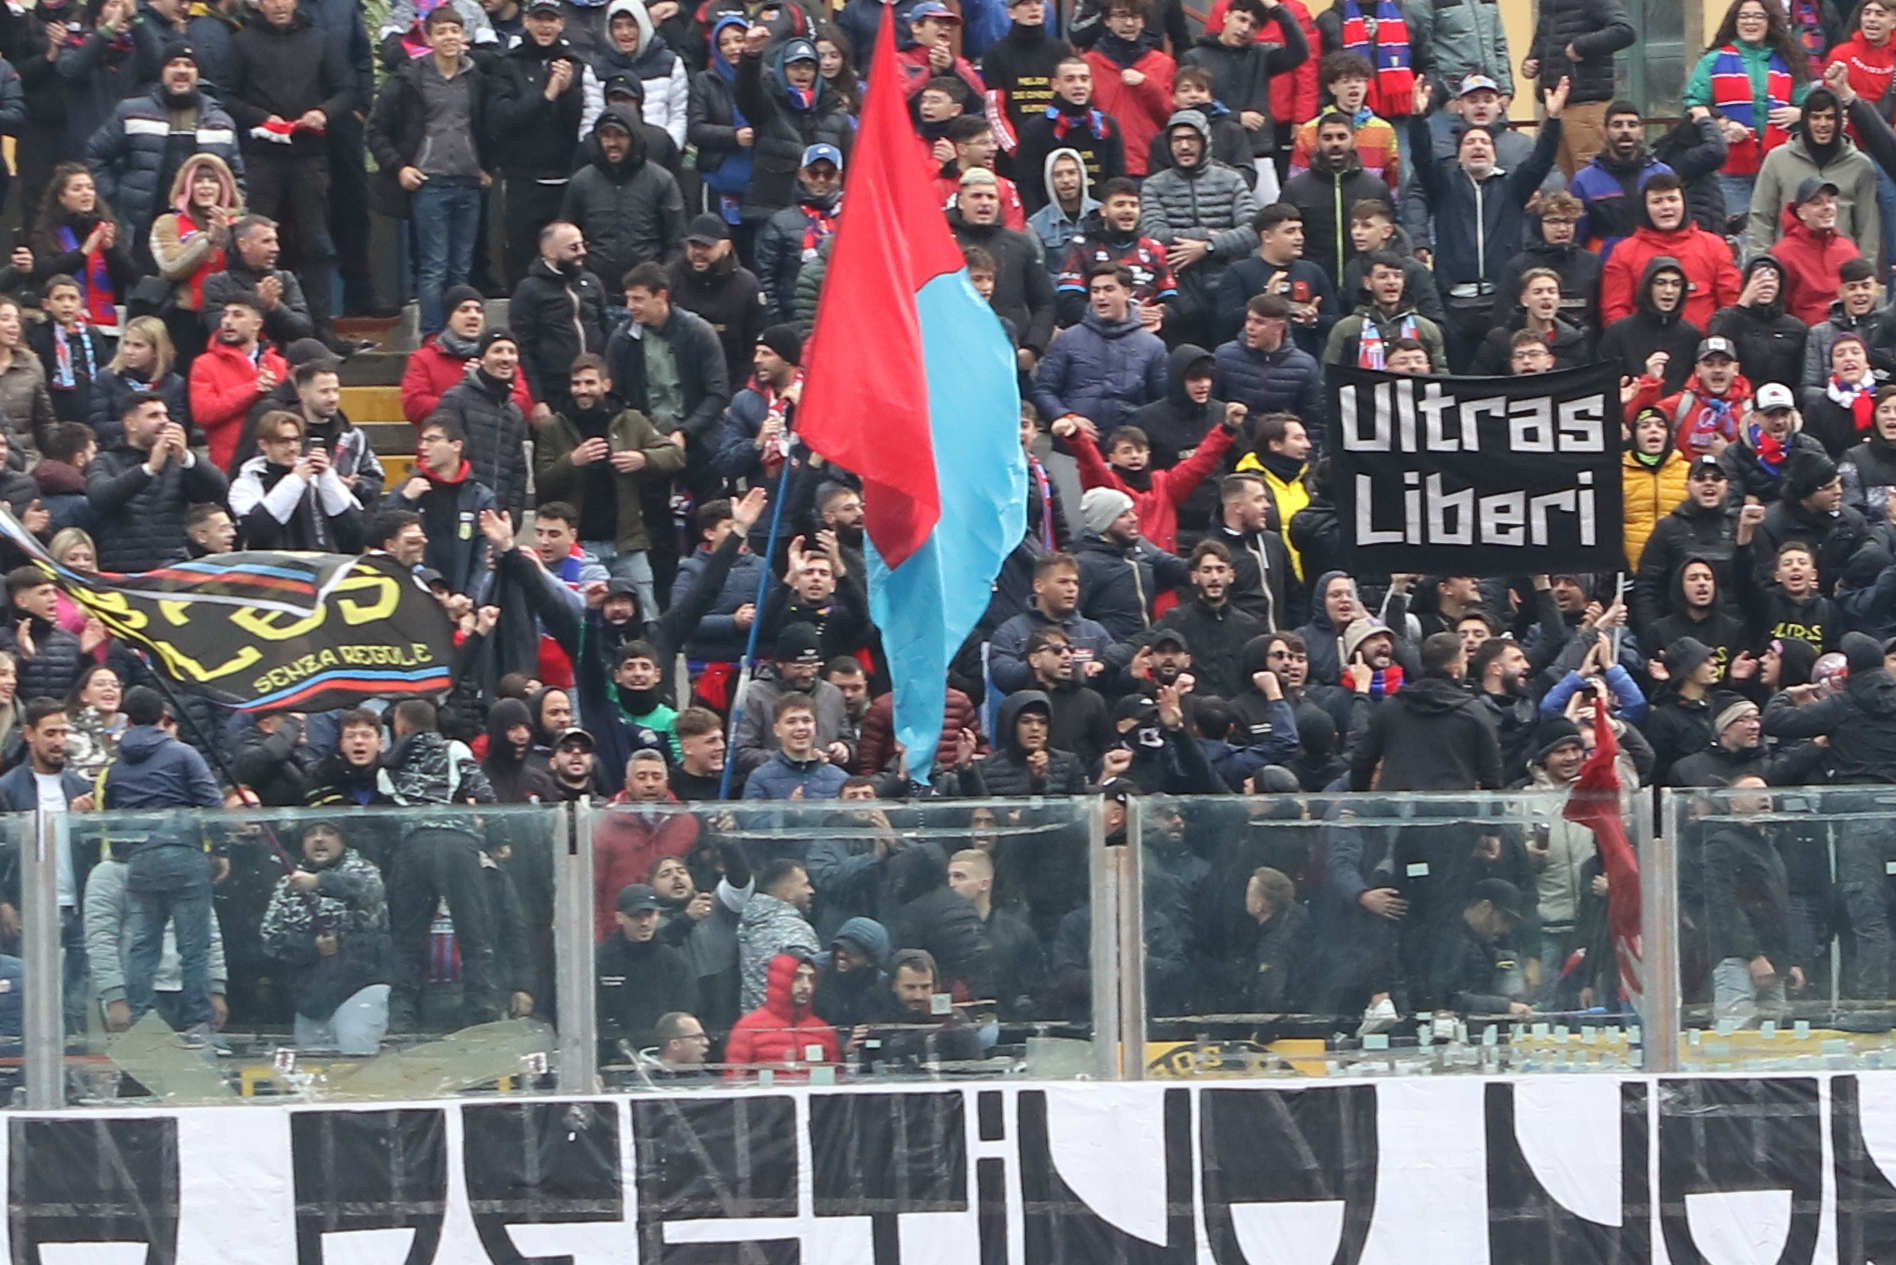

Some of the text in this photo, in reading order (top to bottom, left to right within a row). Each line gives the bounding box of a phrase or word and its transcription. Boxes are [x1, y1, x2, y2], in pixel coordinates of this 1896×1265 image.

[1339, 379, 1605, 453] Ultras
[1355, 471, 1596, 547] Liberi
[253, 643, 433, 694] SENZA REGOLE
